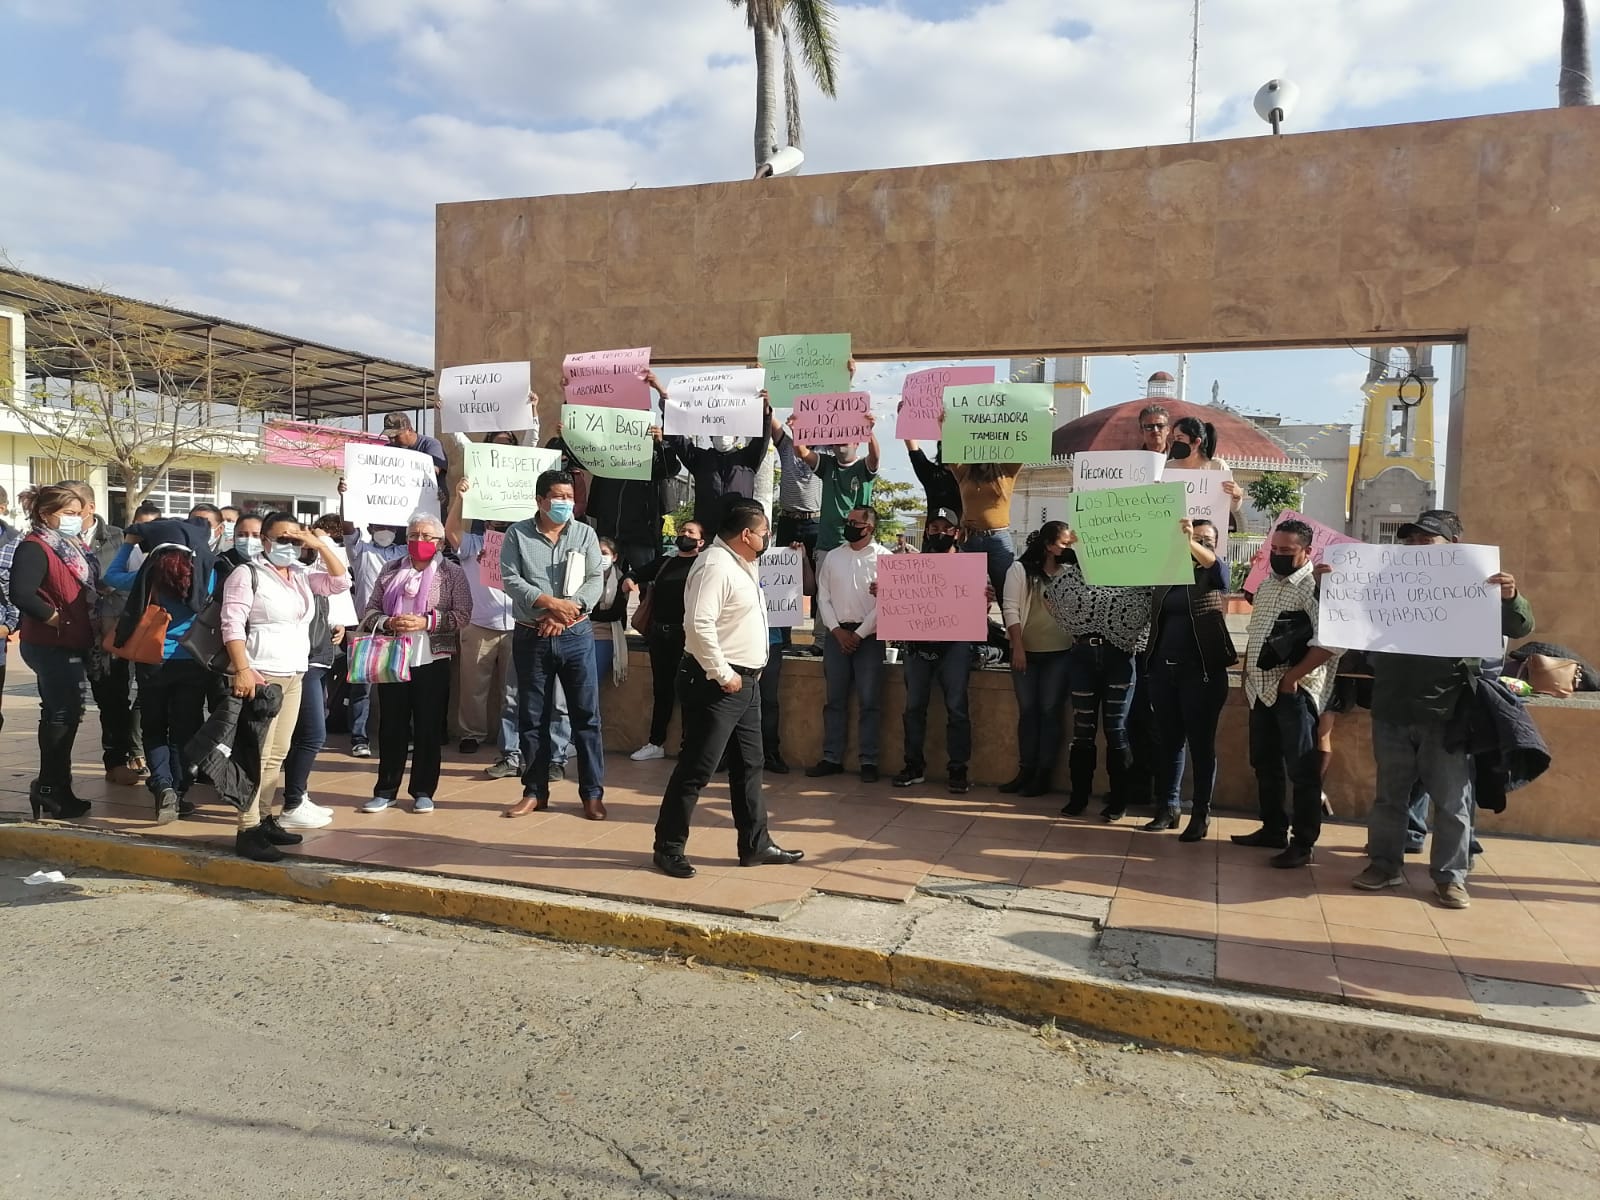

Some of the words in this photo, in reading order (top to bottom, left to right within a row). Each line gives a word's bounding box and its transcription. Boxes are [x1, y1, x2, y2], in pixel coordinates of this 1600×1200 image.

[769, 343, 786, 358] NO
[455, 372, 502, 385] TRABAJO
[570, 366, 609, 378] NUESTROS
[471, 388, 477, 401] Y
[572, 383, 615, 396] LABORALES
[459, 401, 500, 414] DERECHO
[800, 398, 819, 412] NO
[826, 396, 867, 413] SOMOS
[952, 395, 969, 408] LA
[977, 393, 1008, 407] CLASE
[585, 413, 604, 432] YA
[817, 413, 839, 426] 100
[961, 411, 1029, 425] TRABAJADORA
[970, 431, 1009, 441] TAMBIEN
[1015, 430, 1028, 442] ES
[600, 444, 607, 452] a
[357, 453, 405, 468] SINDICATO
[1080, 458, 1124, 481] RECONOCE
[370, 472, 406, 487] JAMAS
[366, 494, 408, 507] VENCIDO
[1107, 491, 1176, 508] Derechos
[1078, 510, 1141, 529] Laborales
[1081, 529, 1143, 545] Derechos
[1086, 542, 1148, 558] Humanos
[880, 558, 935, 573] NUESTRAS
[1381, 549, 1465, 567] ALCALDE
[892, 573, 946, 587] FAMILIAS
[1329, 570, 1433, 587] QUEREMOS
[954, 584, 969, 599] DE
[1325, 587, 1396, 603] NUESTRA
[1407, 582, 1488, 602] UBICACIÓN
[881, 602, 936, 617] NUESTRO
[1327, 608, 1350, 622] DE
[1366, 606, 1448, 626] TRABAJO
[905, 615, 960, 631] TRABAJO
